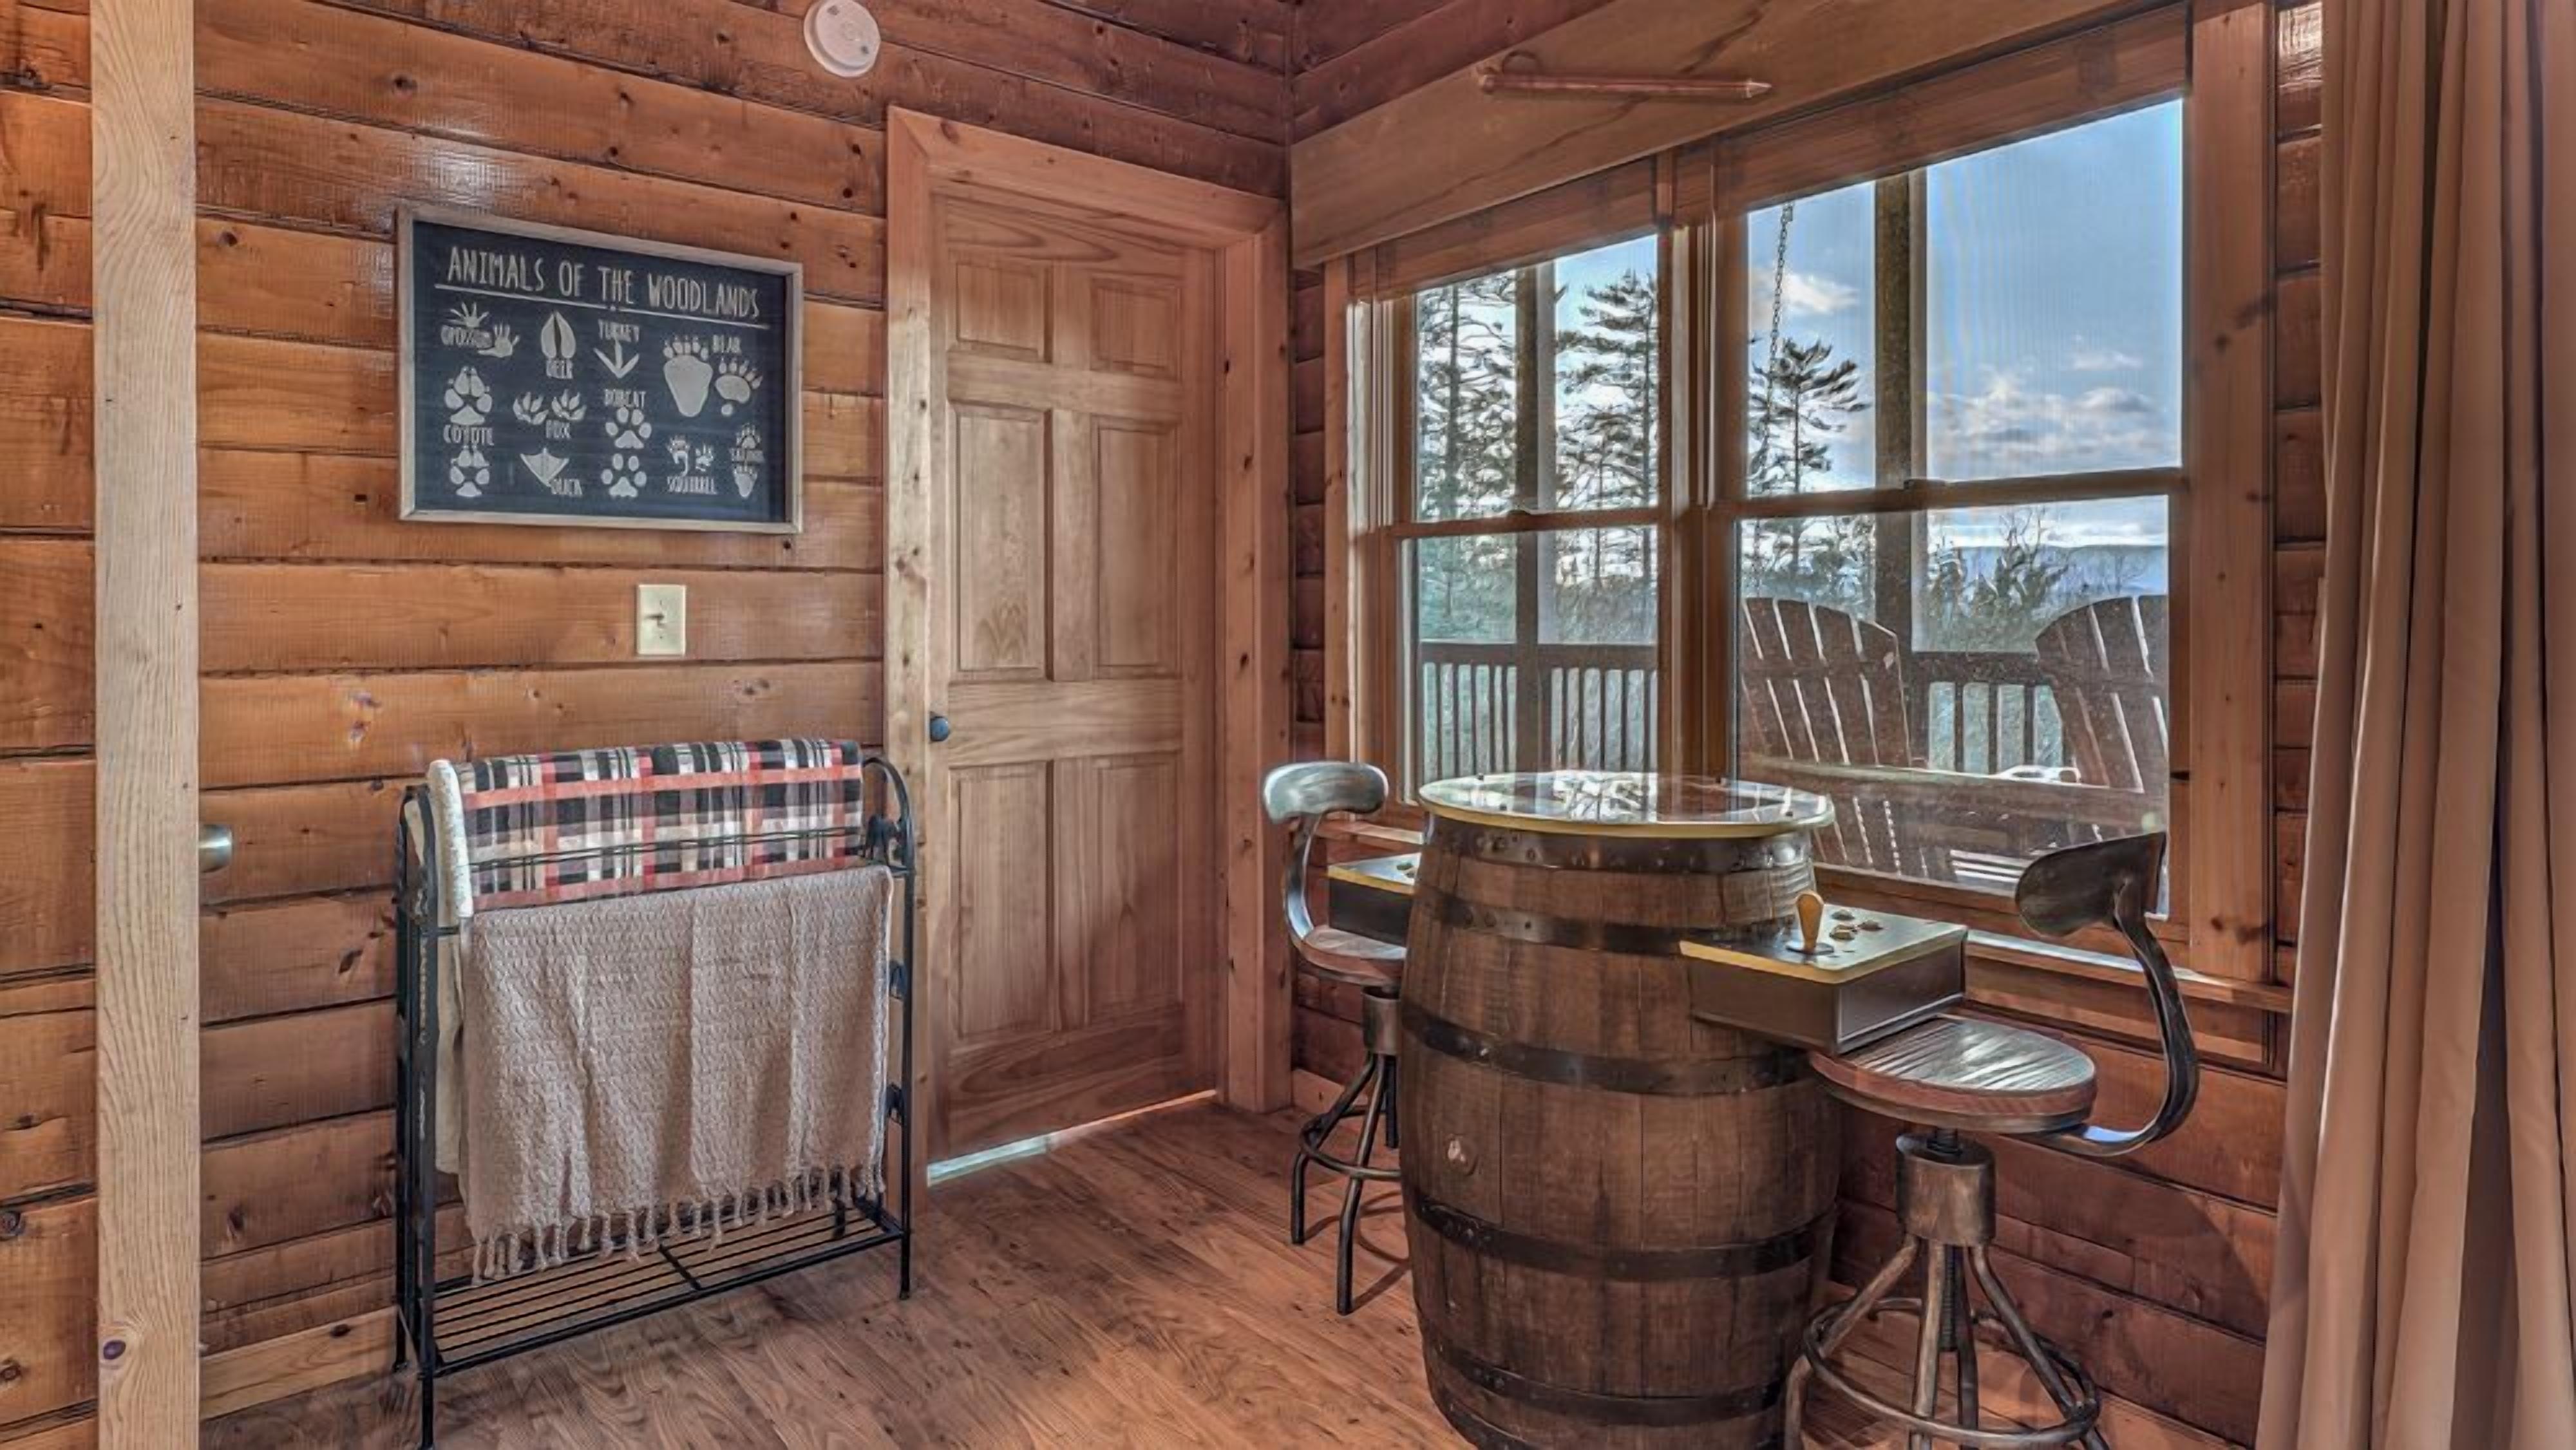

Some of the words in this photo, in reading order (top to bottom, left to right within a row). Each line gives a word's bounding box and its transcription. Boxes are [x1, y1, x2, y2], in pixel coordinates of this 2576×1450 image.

[448, 246, 544, 292] ANIMALS
[558, 259, 585, 297] OF
[598, 266, 634, 305] THE
[647, 273, 760, 318] WOODLANDS
[443, 424, 495, 446] COYOTE
